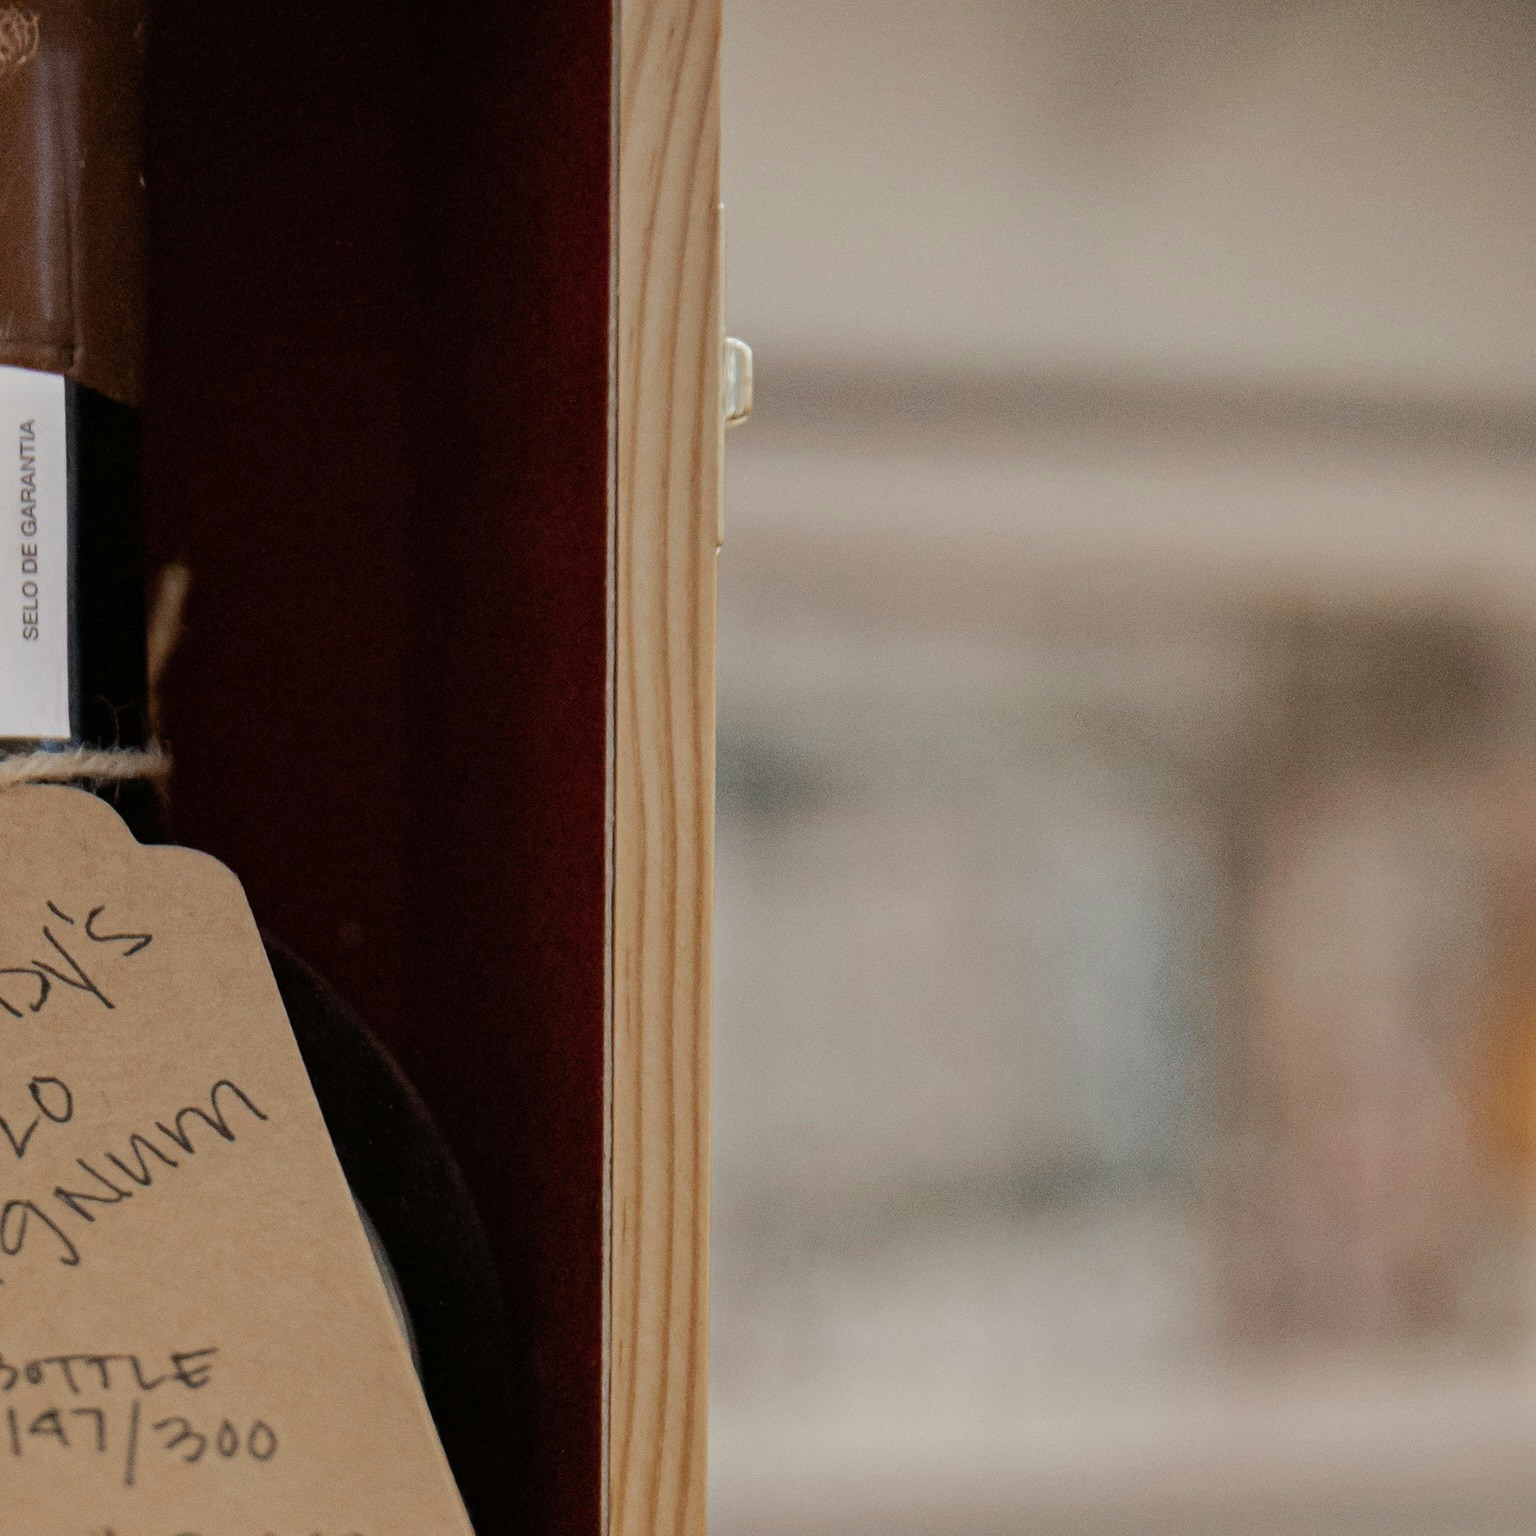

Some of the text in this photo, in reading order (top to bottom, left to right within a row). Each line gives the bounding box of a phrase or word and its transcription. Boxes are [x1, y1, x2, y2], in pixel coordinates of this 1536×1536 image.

[19, 418, 40, 641] SELO DE GARANTIA
